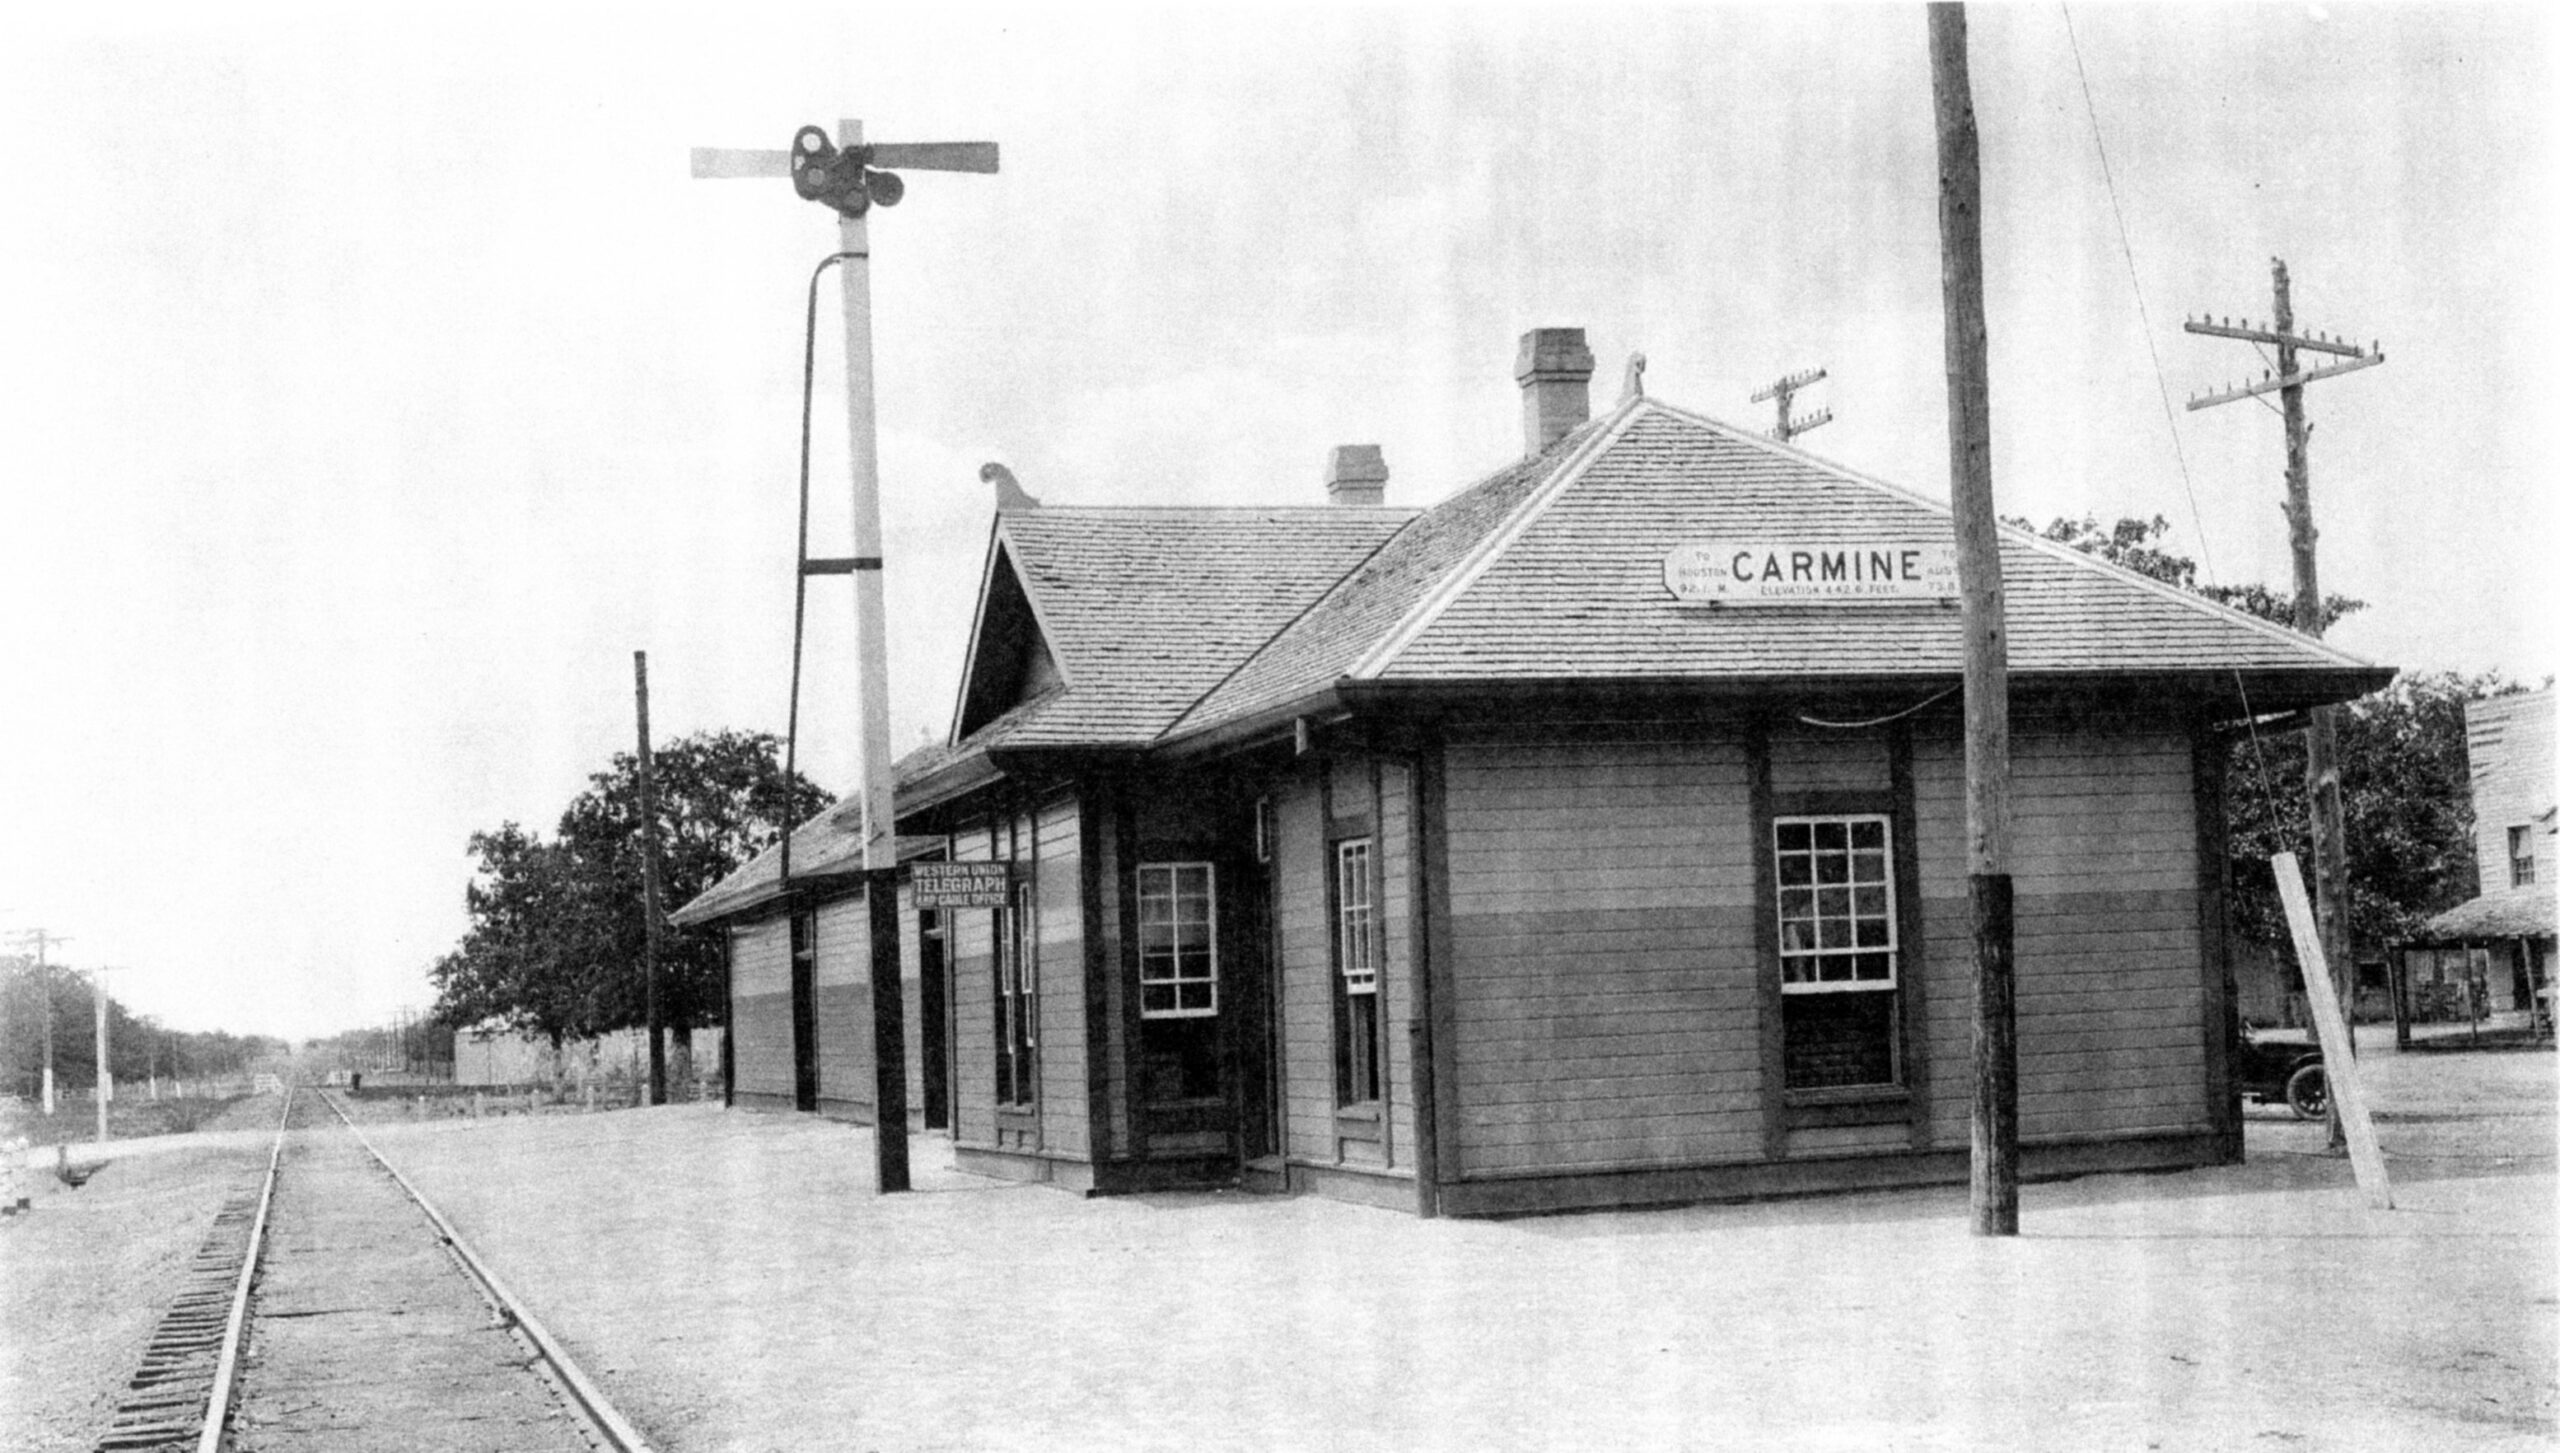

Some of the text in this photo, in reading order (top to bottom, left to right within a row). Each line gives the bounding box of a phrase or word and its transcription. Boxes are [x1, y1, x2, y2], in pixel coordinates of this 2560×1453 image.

[1732, 550, 1922, 582] CARMINE
[1760, 585, 1820, 596] ELEVATION
[913, 864, 1006, 877] WESTERN UNION
[915, 877, 1006, 893] TELEGRAPH
[938, 894, 970, 905] CABLE
[971, 893, 1006, 905] OFFICE
